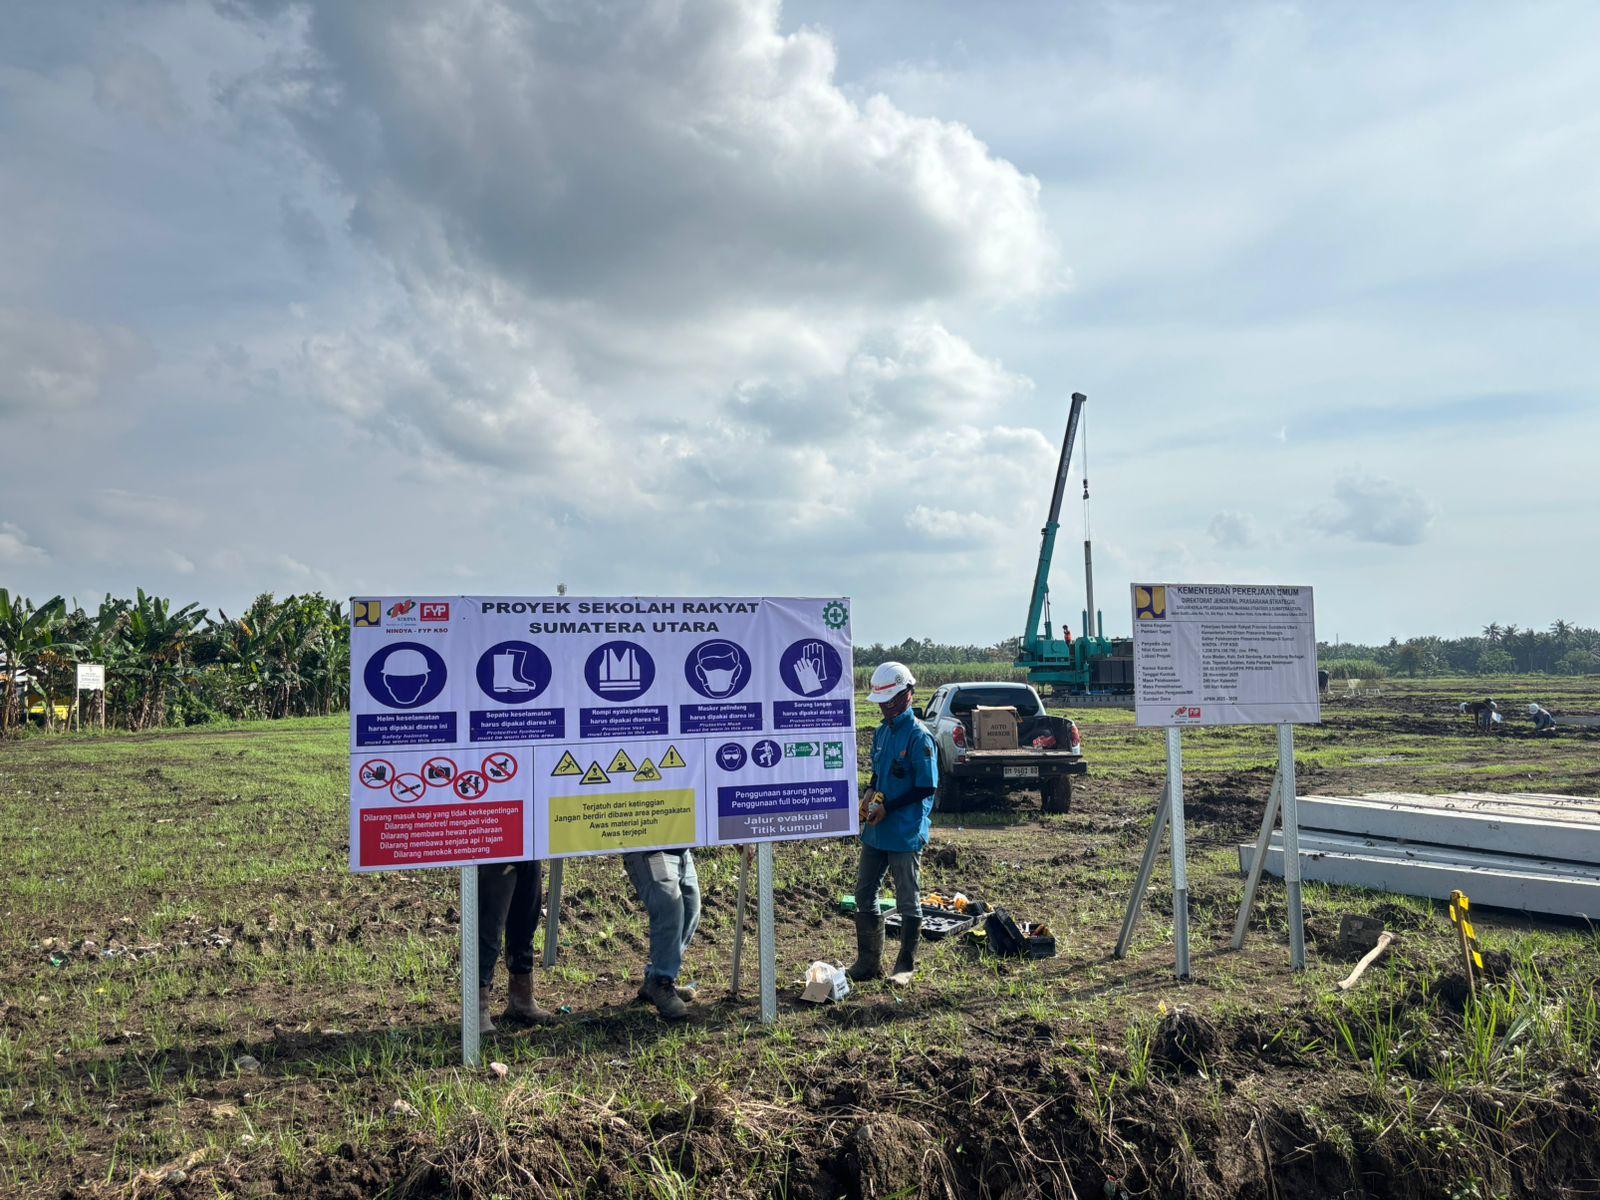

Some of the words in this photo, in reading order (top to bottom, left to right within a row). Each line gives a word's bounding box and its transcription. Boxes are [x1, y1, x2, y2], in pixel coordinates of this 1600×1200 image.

[1177, 587, 1230, 595] KEMENTERIAN
[424, 605, 446, 617] FYP
[481, 602, 571, 614] PROYEK
[578, 602, 675, 614] SEKOLAH
[682, 602, 759, 613] RAKYAT
[529, 622, 646, 634] SUMATERA
[652, 622, 719, 633] UTARA
[736, 790, 780, 799] Penggunaan
[782, 789, 807, 797] sarung
[809, 787, 832, 795] tangan
[583, 803, 612, 811] Terjatuh
[628, 799, 664, 809] ketinggian
[732, 800, 777, 809] Penggunaan
[792, 797, 809, 805] body
[363, 813, 392, 822] Dilarang
[393, 812, 415, 820] masuk
[417, 811, 432, 821] bagi
[432, 811, 450, 820] yang
[451, 809, 467, 817] tidak
[469, 807, 519, 818] berkepentingan
[554, 815, 580, 823] Jangan
[583, 812, 606, 820] berdiri
[607, 810, 633, 818] dibawa
[651, 808, 691, 816] pengakatan
[744, 816, 774, 825] Jalur
[777, 812, 828, 822] evakuasi
[384, 822, 412, 831] Dilarang
[611, 820, 639, 828] material
[640, 819, 658, 827] jatuh
[751, 826, 777, 835] Titik
[780, 823, 822, 833] kumpul
[380, 832, 408, 841] Dilarang
[410, 830, 444, 838] membawa
[468, 827, 502, 837] peliharaan
[622, 829, 647, 838] terjepit
[380, 841, 408, 850] Dilarang
[409, 839, 443, 848] membawa
[445, 838, 468, 847] senjata
[470, 837, 480, 846] api
[485, 836, 503, 844] tajam
[394, 850, 422, 859] Dilarang
[423, 848, 452, 856] merokok
[453, 846, 490, 855] sembarang
